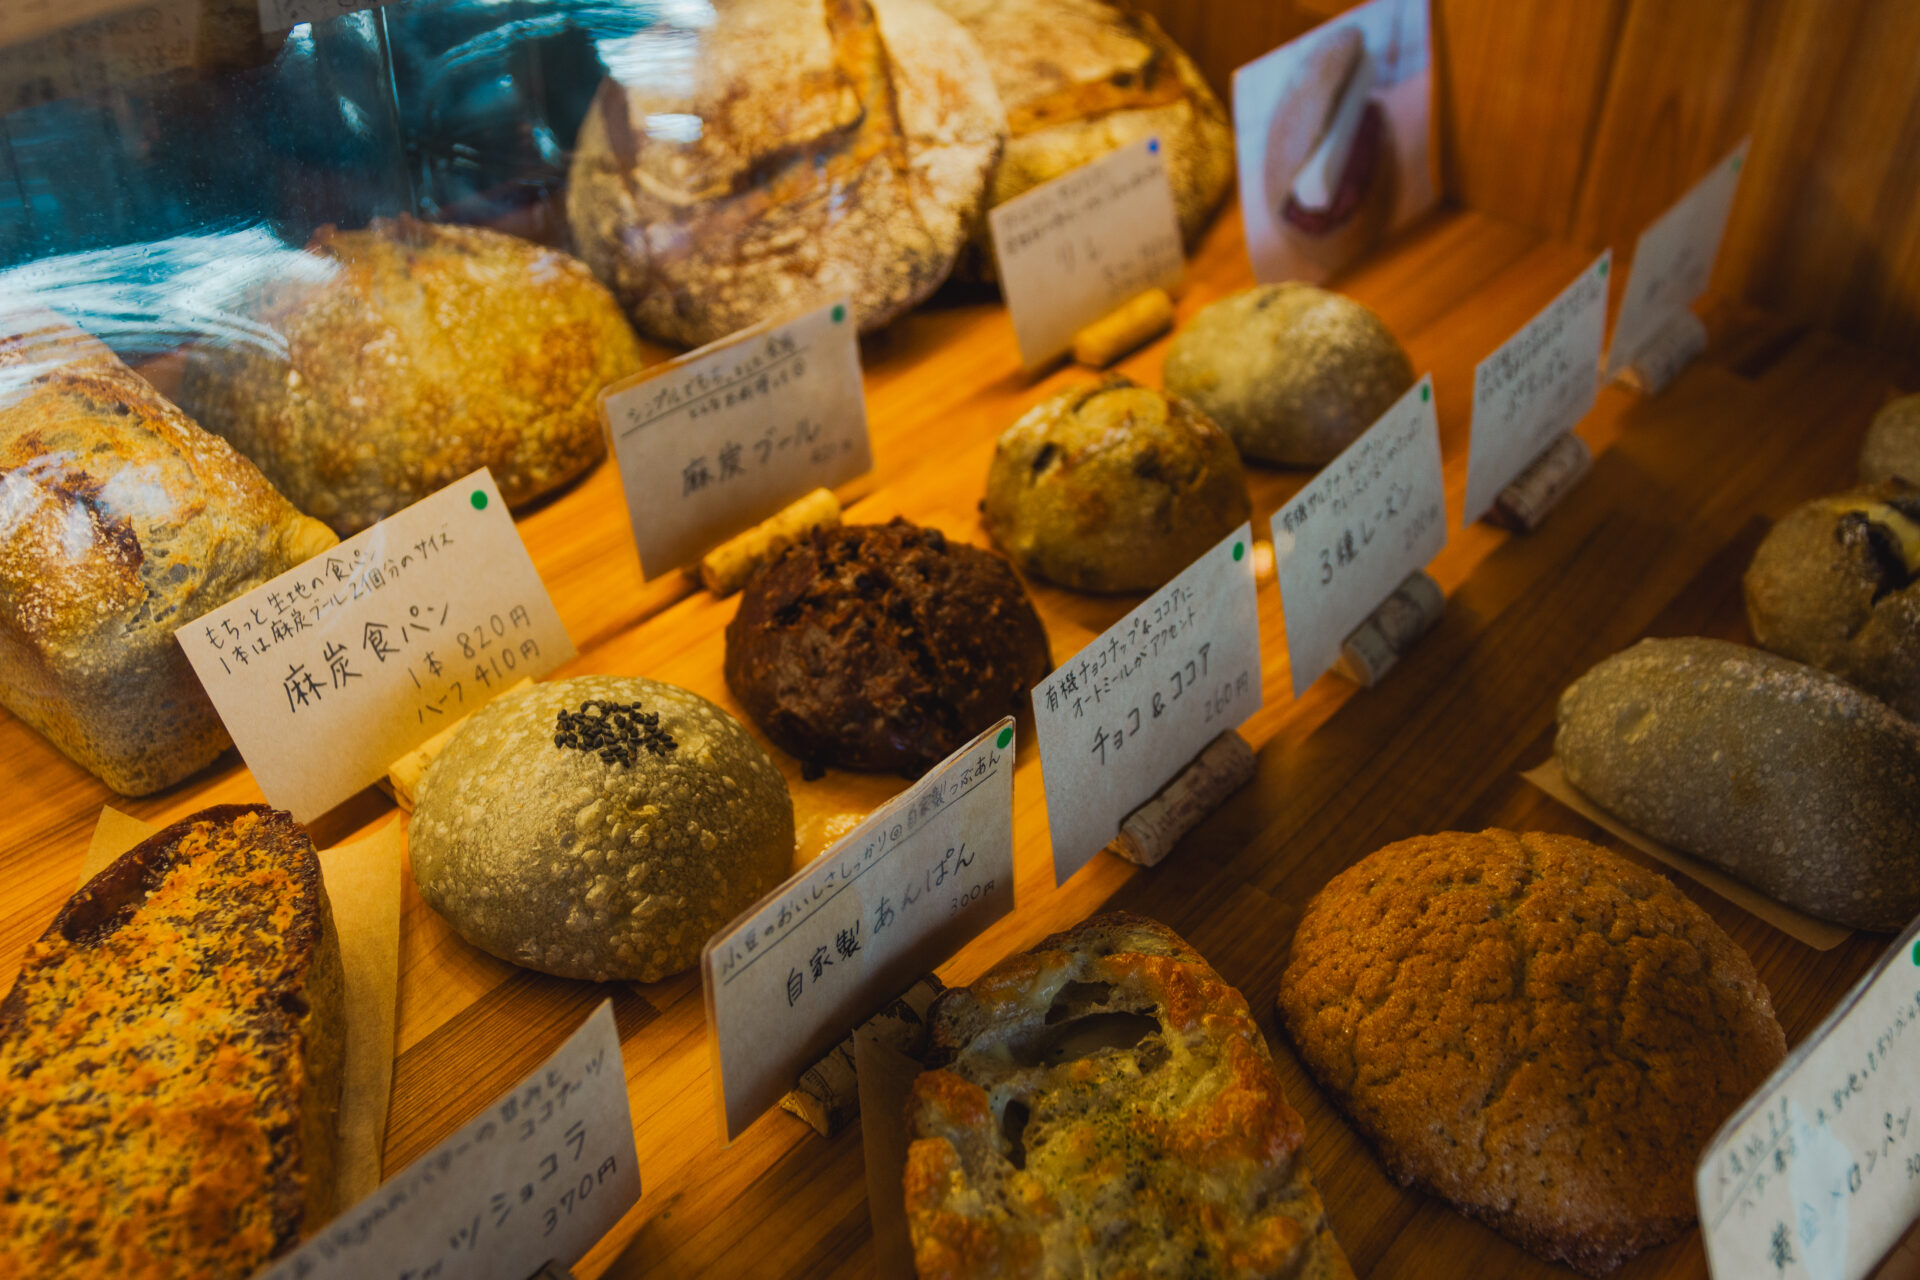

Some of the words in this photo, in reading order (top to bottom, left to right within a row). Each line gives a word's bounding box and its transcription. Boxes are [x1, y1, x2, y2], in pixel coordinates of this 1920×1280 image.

[205, 549, 376, 650] もちっと生地の食パン
[283, 602, 450, 714] 麻炭食パン
[543, 1155, 617, 1237] 370円
